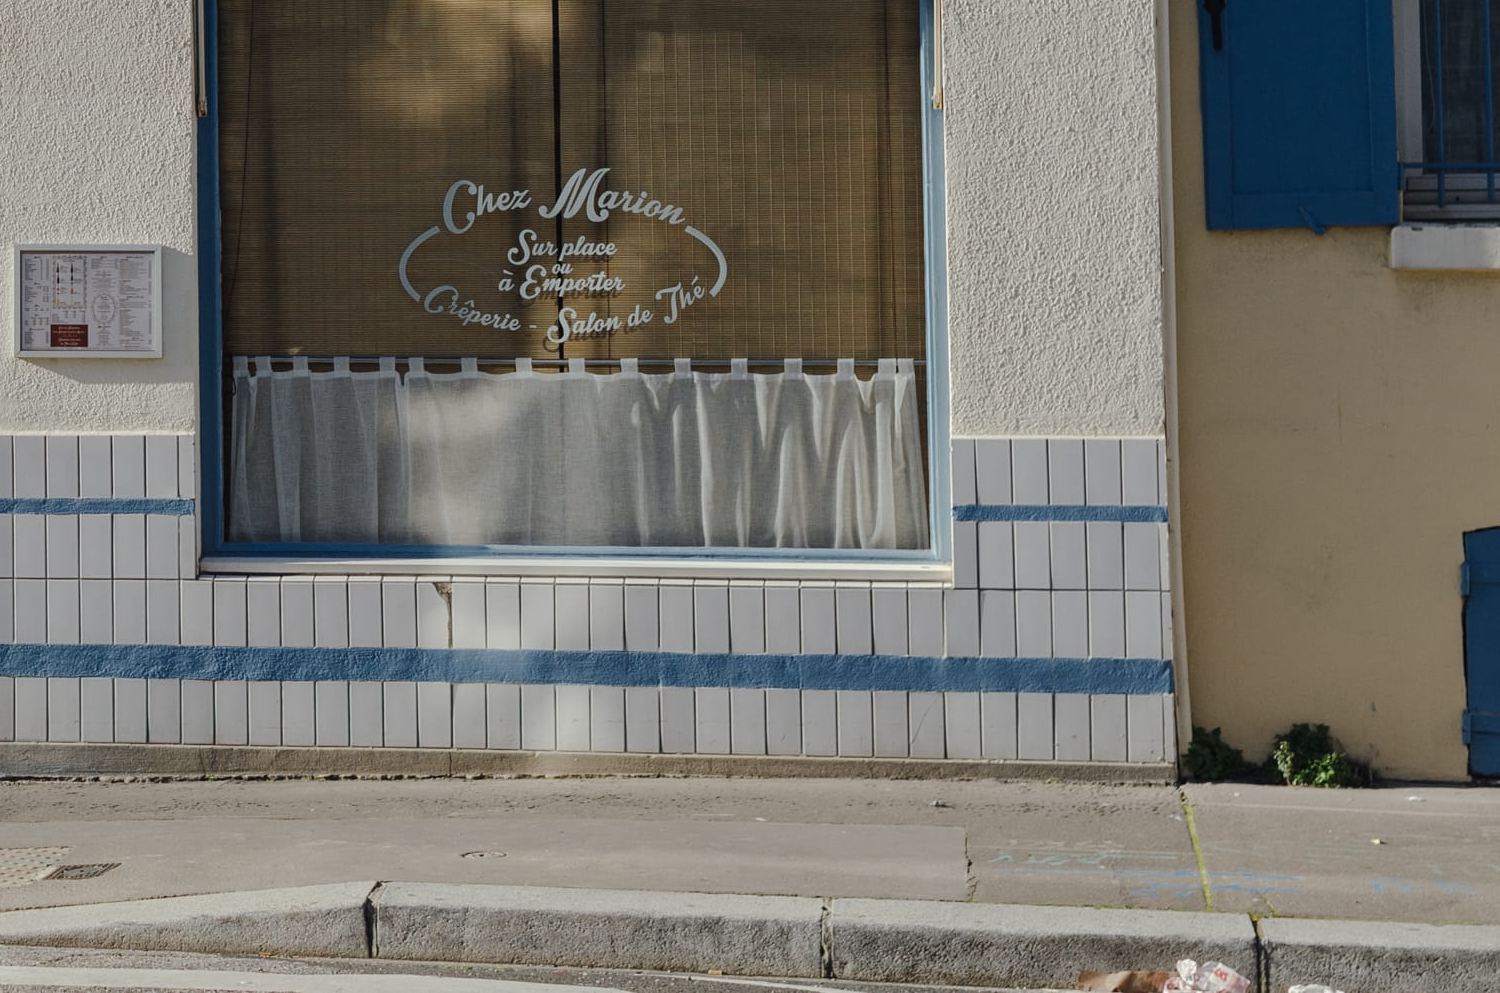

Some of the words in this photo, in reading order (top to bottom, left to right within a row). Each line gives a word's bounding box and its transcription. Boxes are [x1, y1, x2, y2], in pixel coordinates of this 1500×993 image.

[443, 179, 532, 235] Chez
[538, 167, 686, 226] Marion
[507, 229, 559, 266] Sur
[558, 235, 618, 262] place
[498, 269, 514, 292] à
[519, 264, 625, 300] Emporter
[552, 262, 573, 275] ou
[424, 285, 522, 331] Crêperie
[546, 307, 622, 344] Salon
[628, 305, 653, 328] de
[655, 276, 705, 324] Thé
